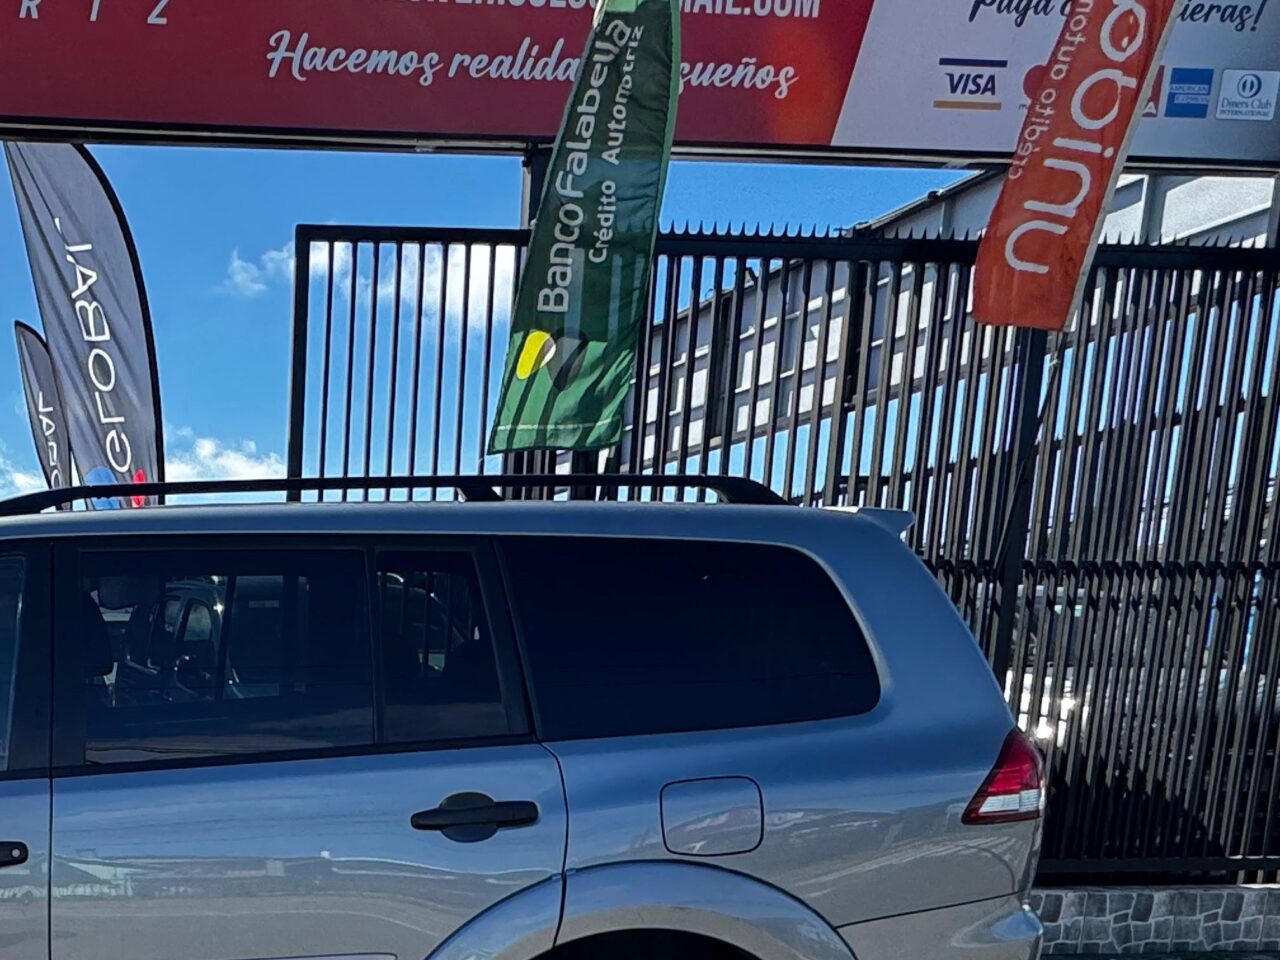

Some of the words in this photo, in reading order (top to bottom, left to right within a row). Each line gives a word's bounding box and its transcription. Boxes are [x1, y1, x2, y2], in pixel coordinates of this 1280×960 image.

[266, 29, 444, 87] Hacemos
[448, 36, 583, 83] realida
[600, 25, 645, 167] Automotriz
[944, 72, 997, 97] VISA
[555, 19, 632, 199] Falabella
[536, 203, 585, 314] Banco
[587, 180, 617, 264] Crédito
